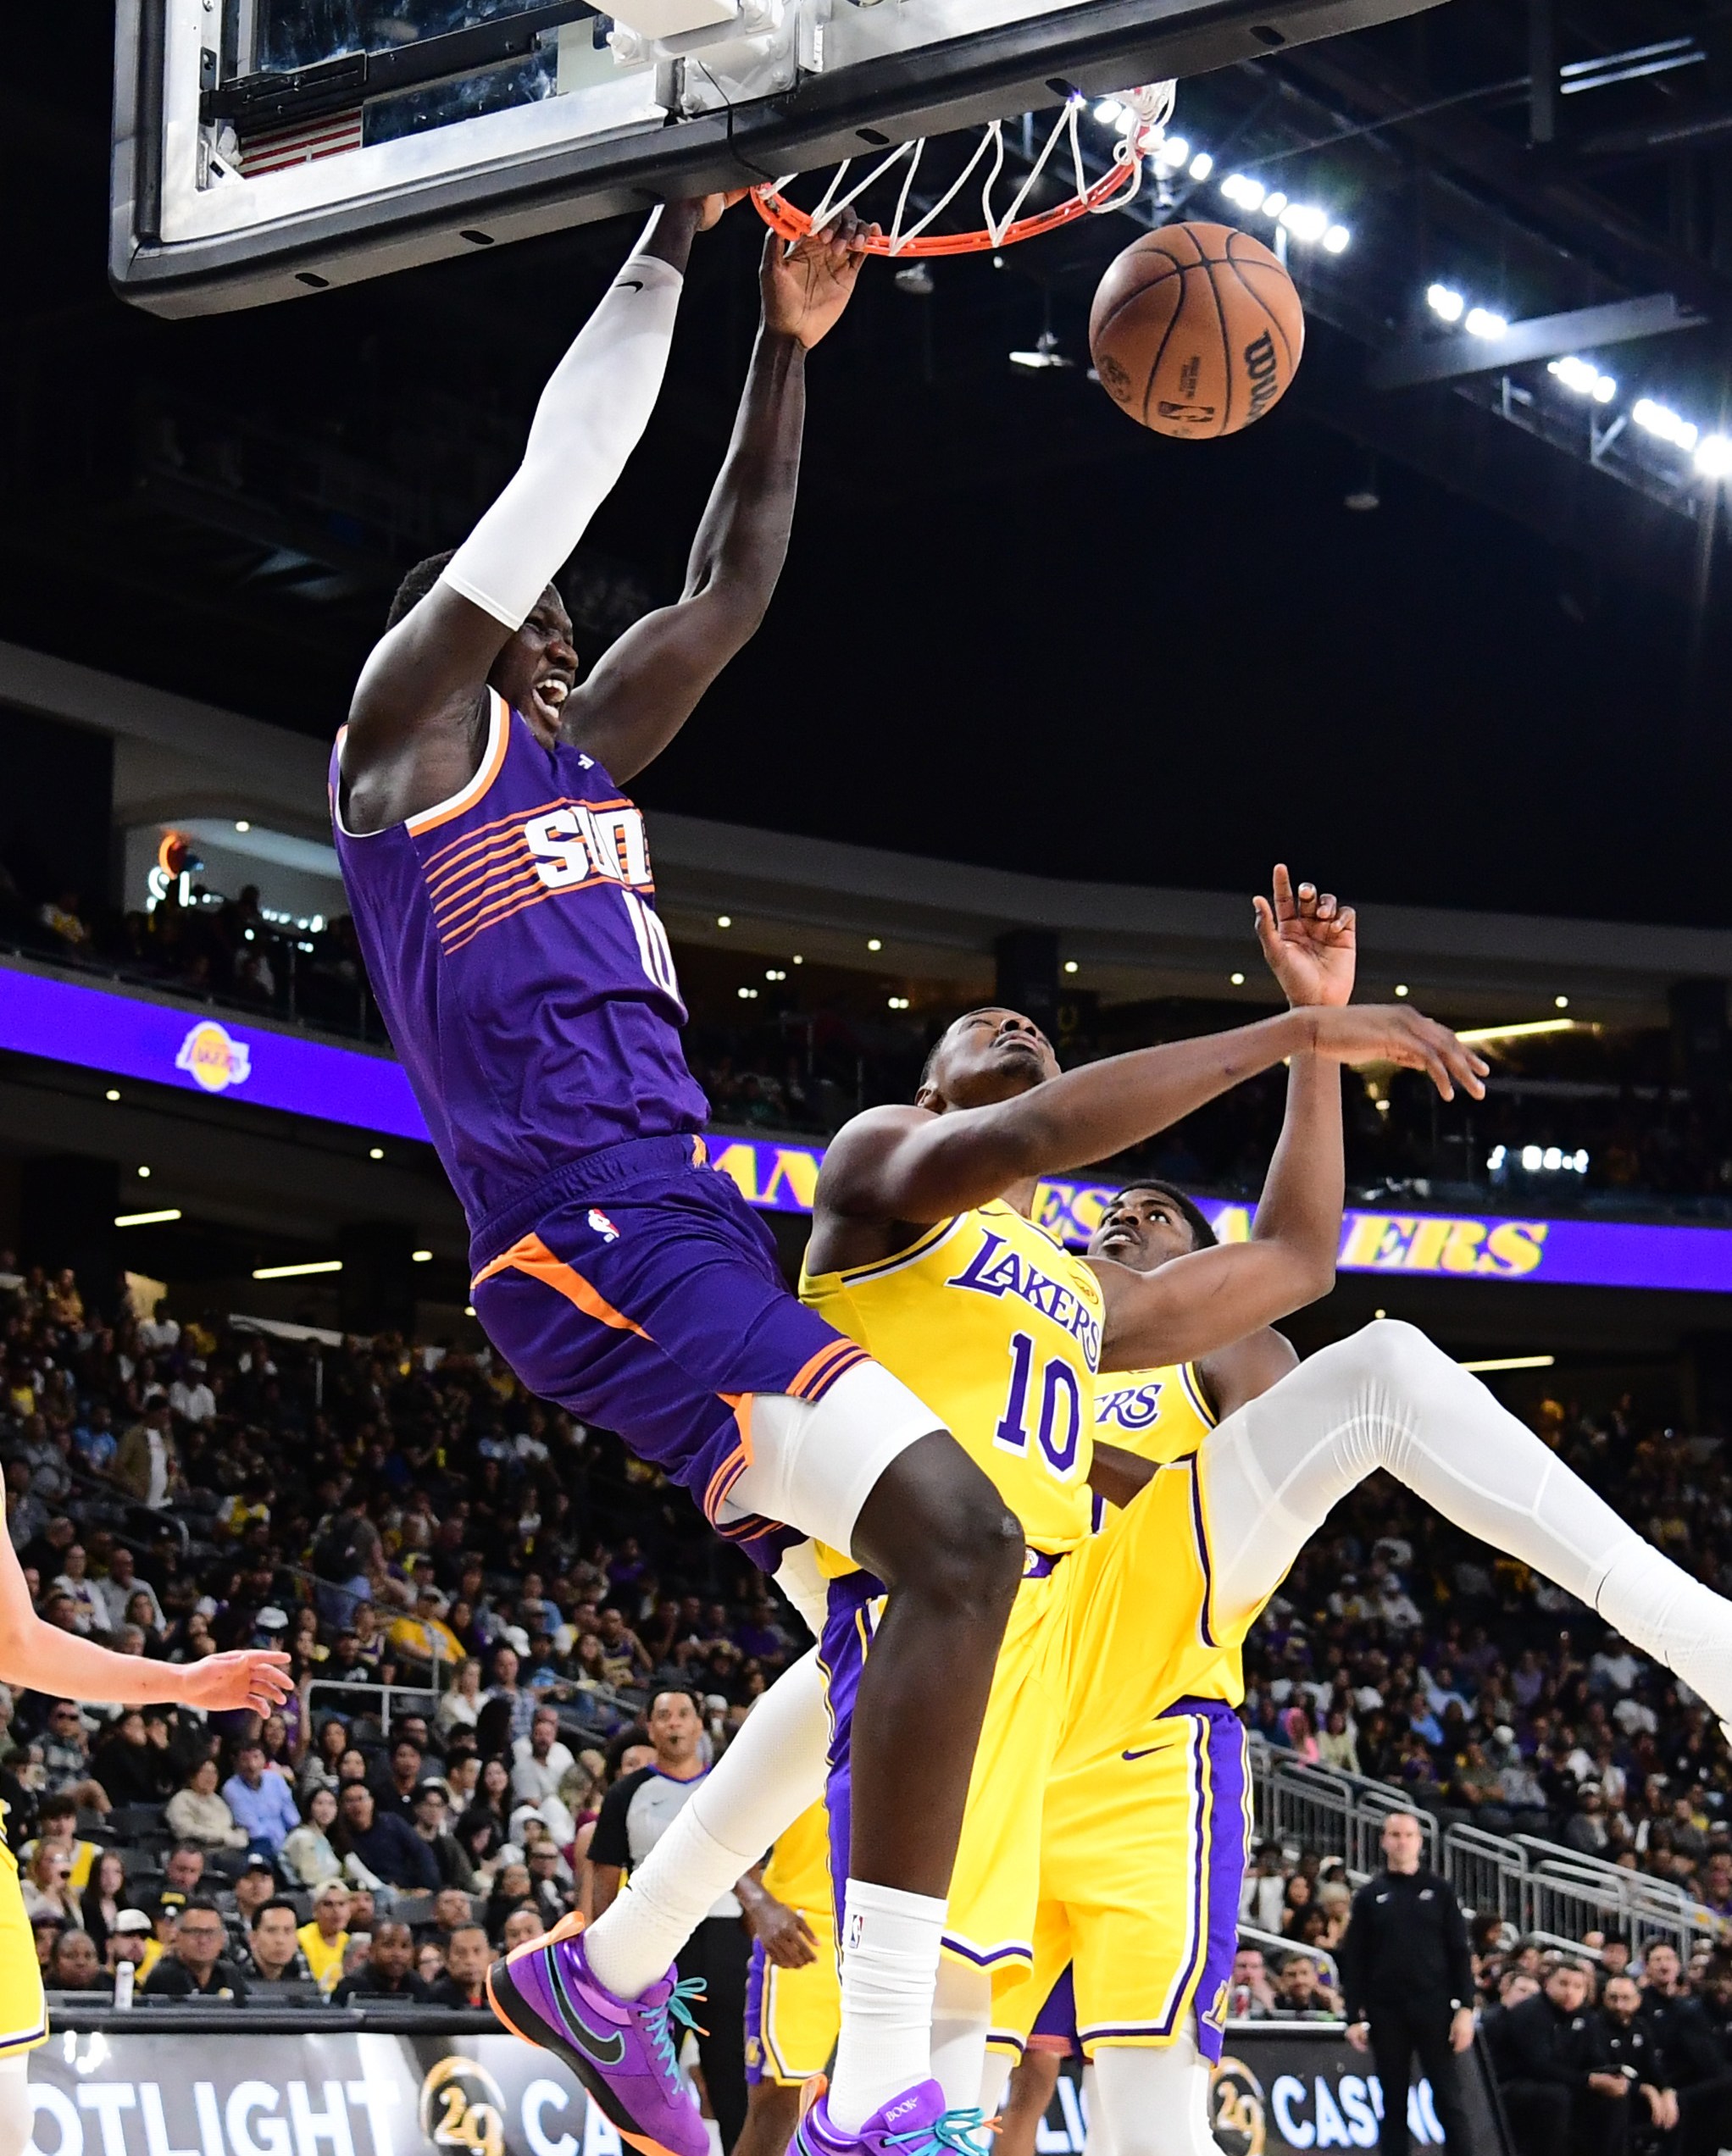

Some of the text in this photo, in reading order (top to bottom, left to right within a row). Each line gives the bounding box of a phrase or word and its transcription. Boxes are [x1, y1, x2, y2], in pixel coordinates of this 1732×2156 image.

[945, 1228, 1101, 1374] LAKERS
[994, 1330, 1081, 1477] 10
[24, 2080, 399, 2156] OTLIGHT
[520, 2078, 624, 2156] CA
[885, 2097, 919, 2121] BOOK
